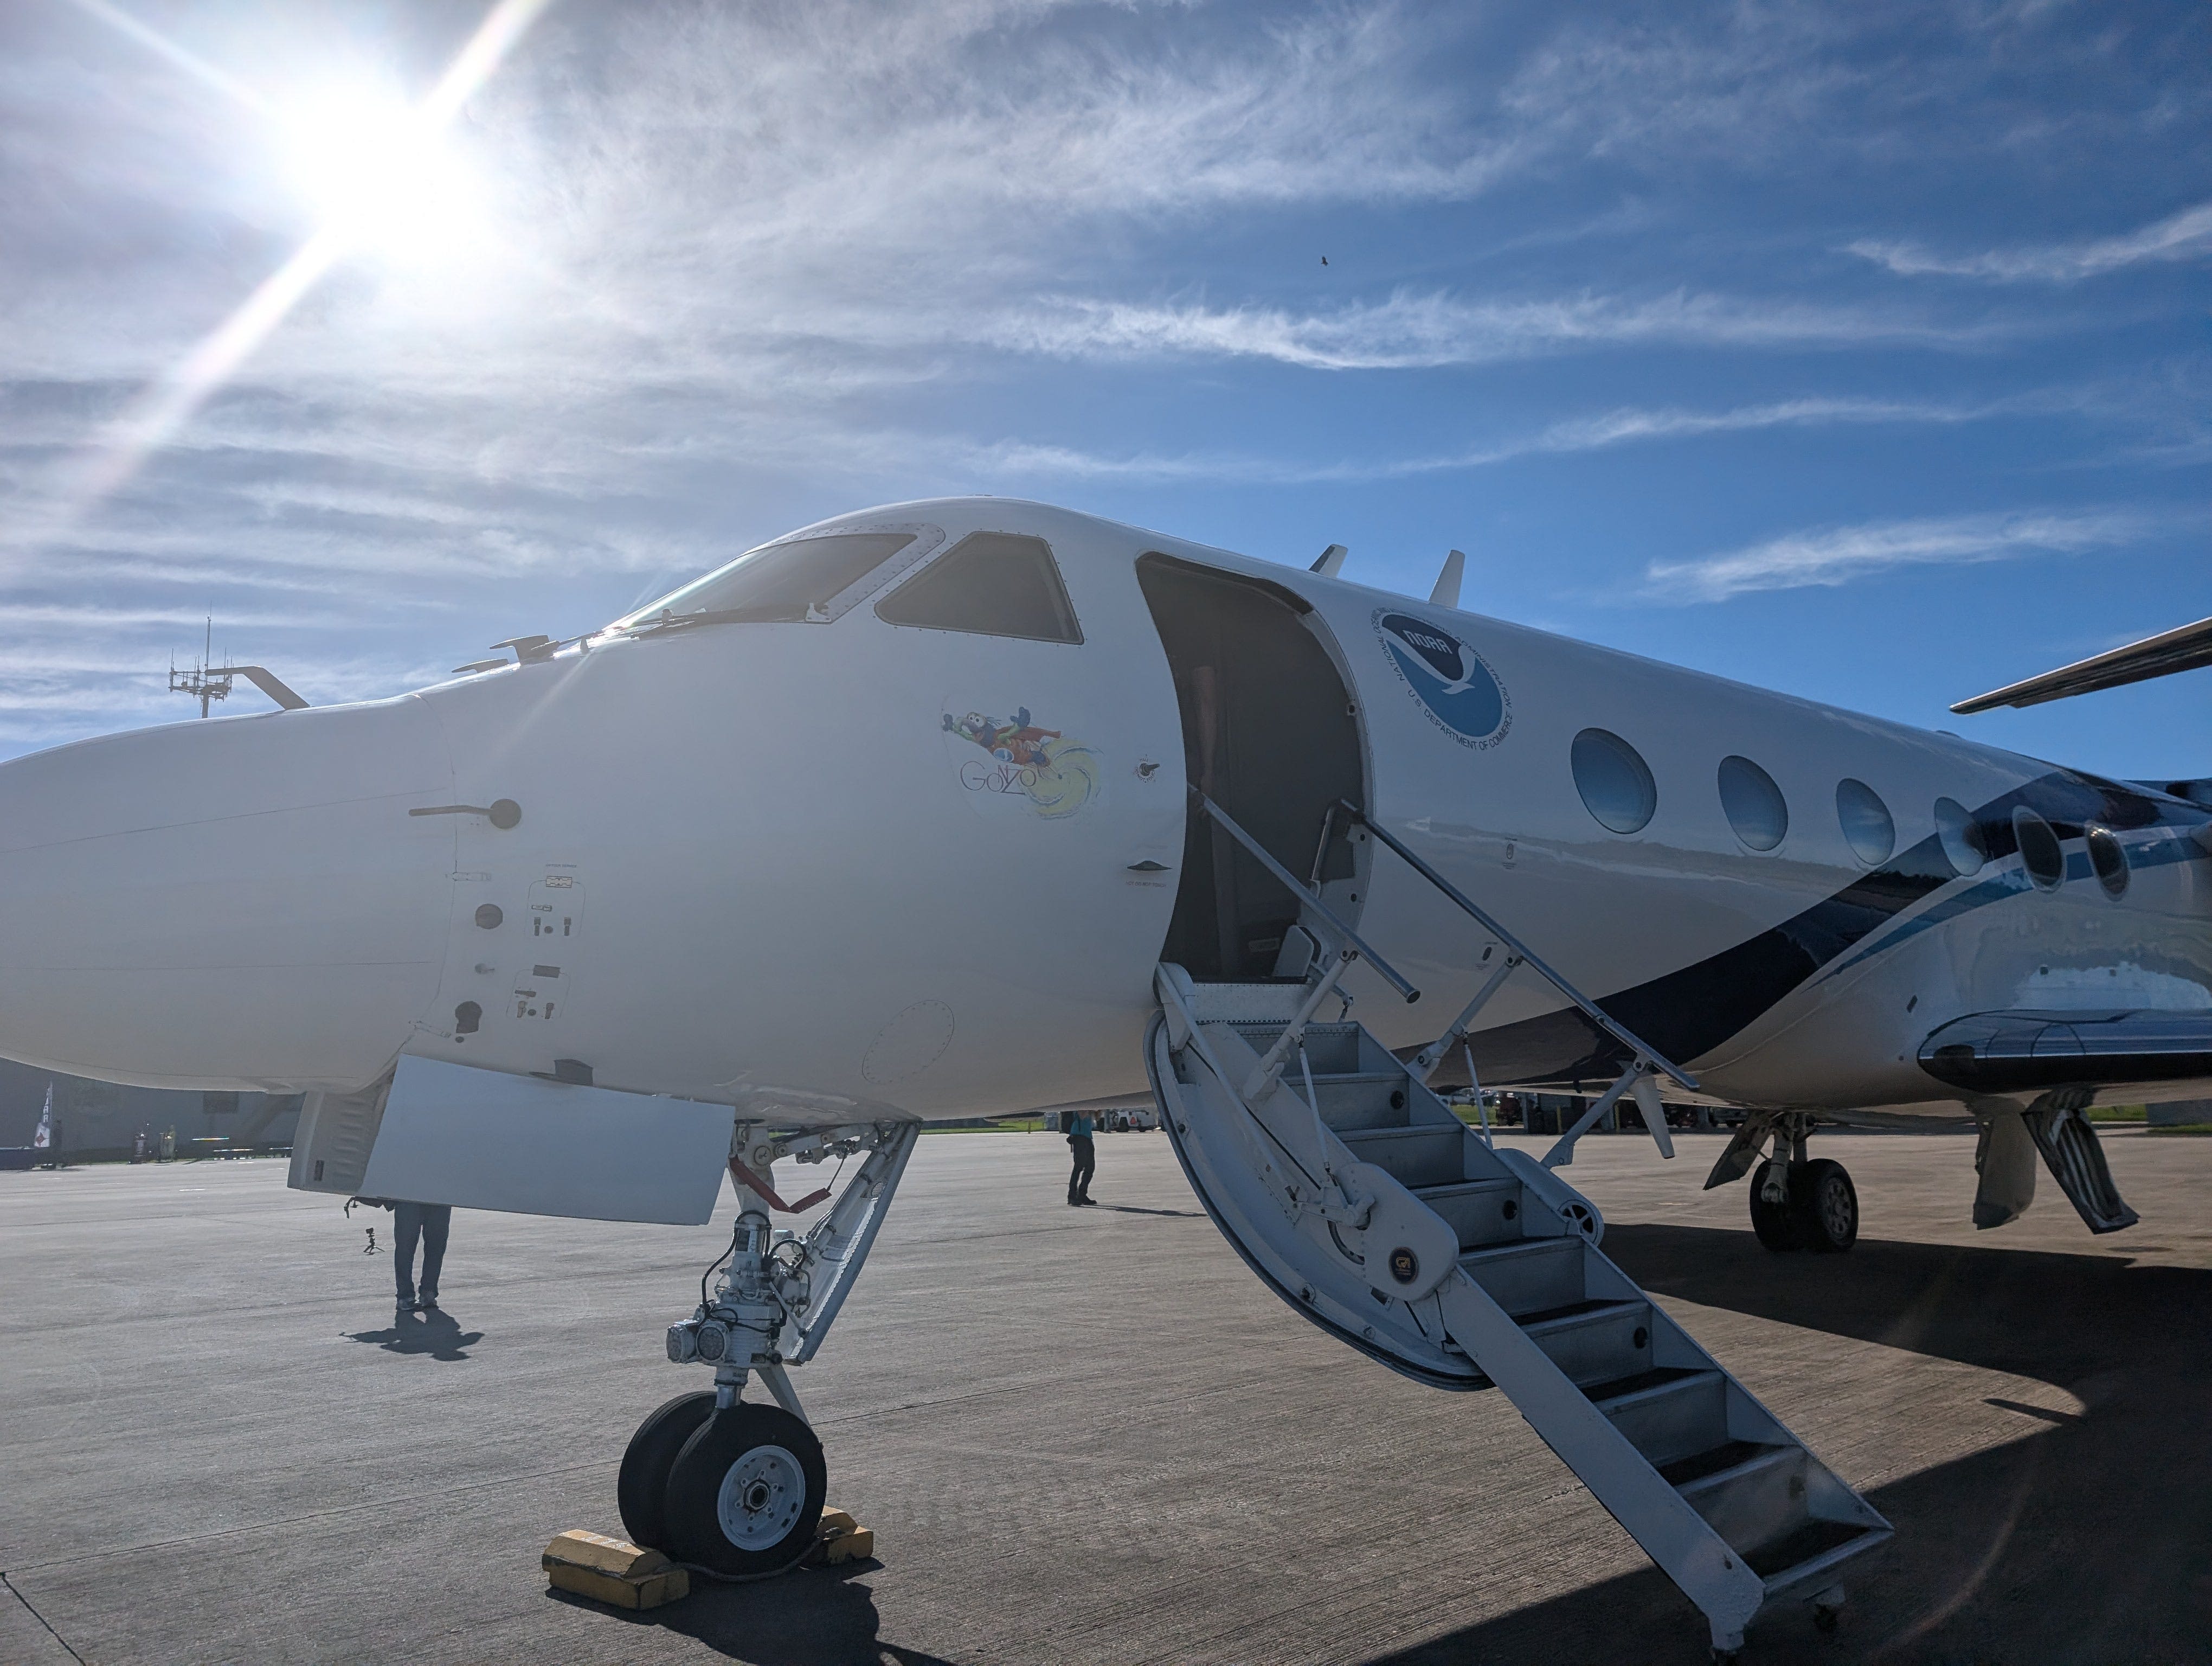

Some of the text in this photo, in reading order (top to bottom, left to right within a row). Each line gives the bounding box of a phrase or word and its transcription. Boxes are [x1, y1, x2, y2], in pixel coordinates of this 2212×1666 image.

[1378, 636, 1406, 681] NATIONAL
[1455, 636, 1512, 709] ADMINISTRATION
[1402, 630, 1454, 655] NOAA
[1408, 689, 1513, 751] U.S. DEPARTMENT OF COMMERCE
